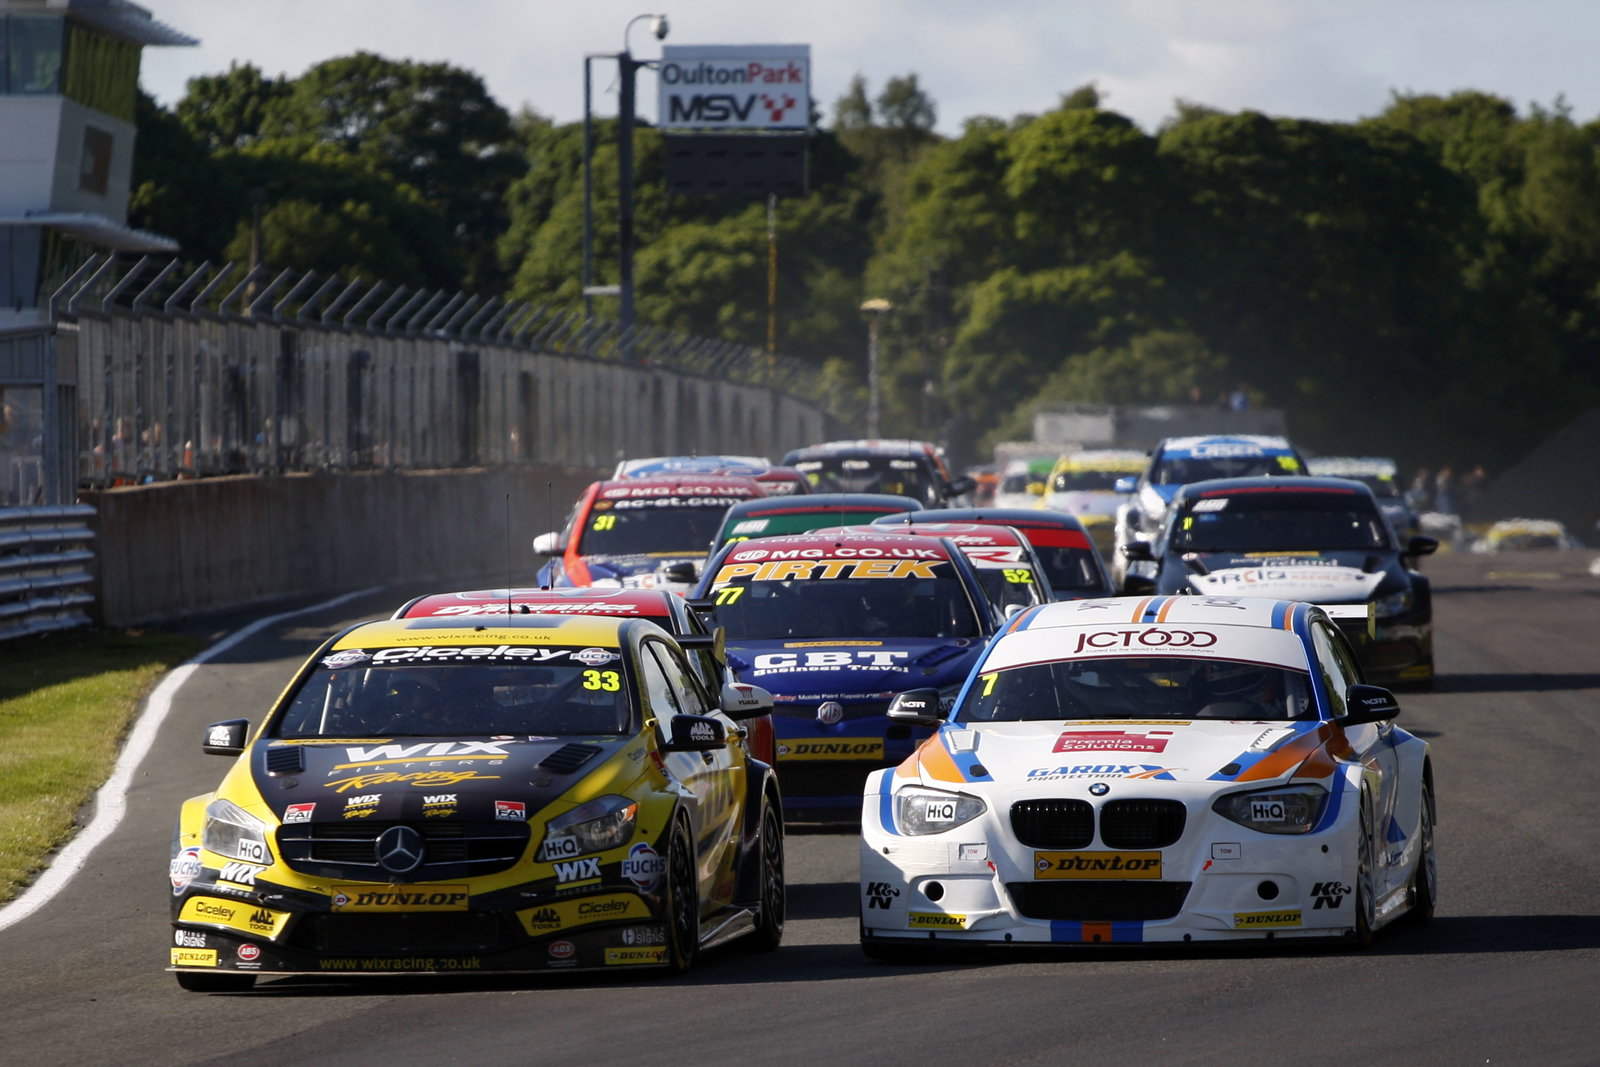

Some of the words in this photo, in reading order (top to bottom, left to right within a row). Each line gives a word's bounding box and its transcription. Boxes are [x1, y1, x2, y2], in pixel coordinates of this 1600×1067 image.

[661, 61, 803, 84] OultonPark
[668, 94, 757, 122] MSV
[631, 486, 752, 498] MG.CO.UK
[593, 515, 616, 531] 31
[771, 548, 941, 559] MG.CO.UK
[713, 559, 950, 584] PIRTEK
[1002, 569, 1034, 584] 52
[715, 587, 745, 605] 77
[396, 633, 552, 642] www.wixracing.co.uk
[1073, 628, 1218, 654] JCT600
[372, 646, 572, 661] Ciceley
[754, 651, 909, 669] CBT
[582, 670, 621, 692] 33
[982, 672, 998, 697] 7
[345, 740, 518, 763] WIX
[794, 743, 882, 755] DUNLOP
[328, 759, 504, 776] FILTERS
[1027, 773, 1123, 782] PROTECTION
[348, 793, 383, 805] WIX
[422, 793, 458, 804] WIX
[927, 804, 954, 819] HiQ
[1252, 804, 1283, 819] HiQ
[240, 842, 263, 859] HiQ
[545, 839, 576, 857] HiQ
[170, 860, 201, 876] FUCHS
[553, 857, 602, 883] WIX
[623, 858, 666, 876] FUCHS
[1055, 858, 1160, 870] DUNLOP
[220, 862, 269, 885] WIX
[354, 893, 468, 905] DUNLOP
[195, 901, 237, 920] Ciceley
[578, 900, 630, 915] Ciceley
[531, 908, 561, 923] MAC
[917, 916, 967, 926] DUNLOP
[1245, 913, 1302, 924] DUNLOP
[249, 923, 274, 932] TOOLS
[531, 922, 561, 930] TOOLS
[636, 932, 665, 944] SIGNS
[178, 952, 213, 961] DUNLOP
[319, 956, 481, 971] wwwwixracing.o.uk
